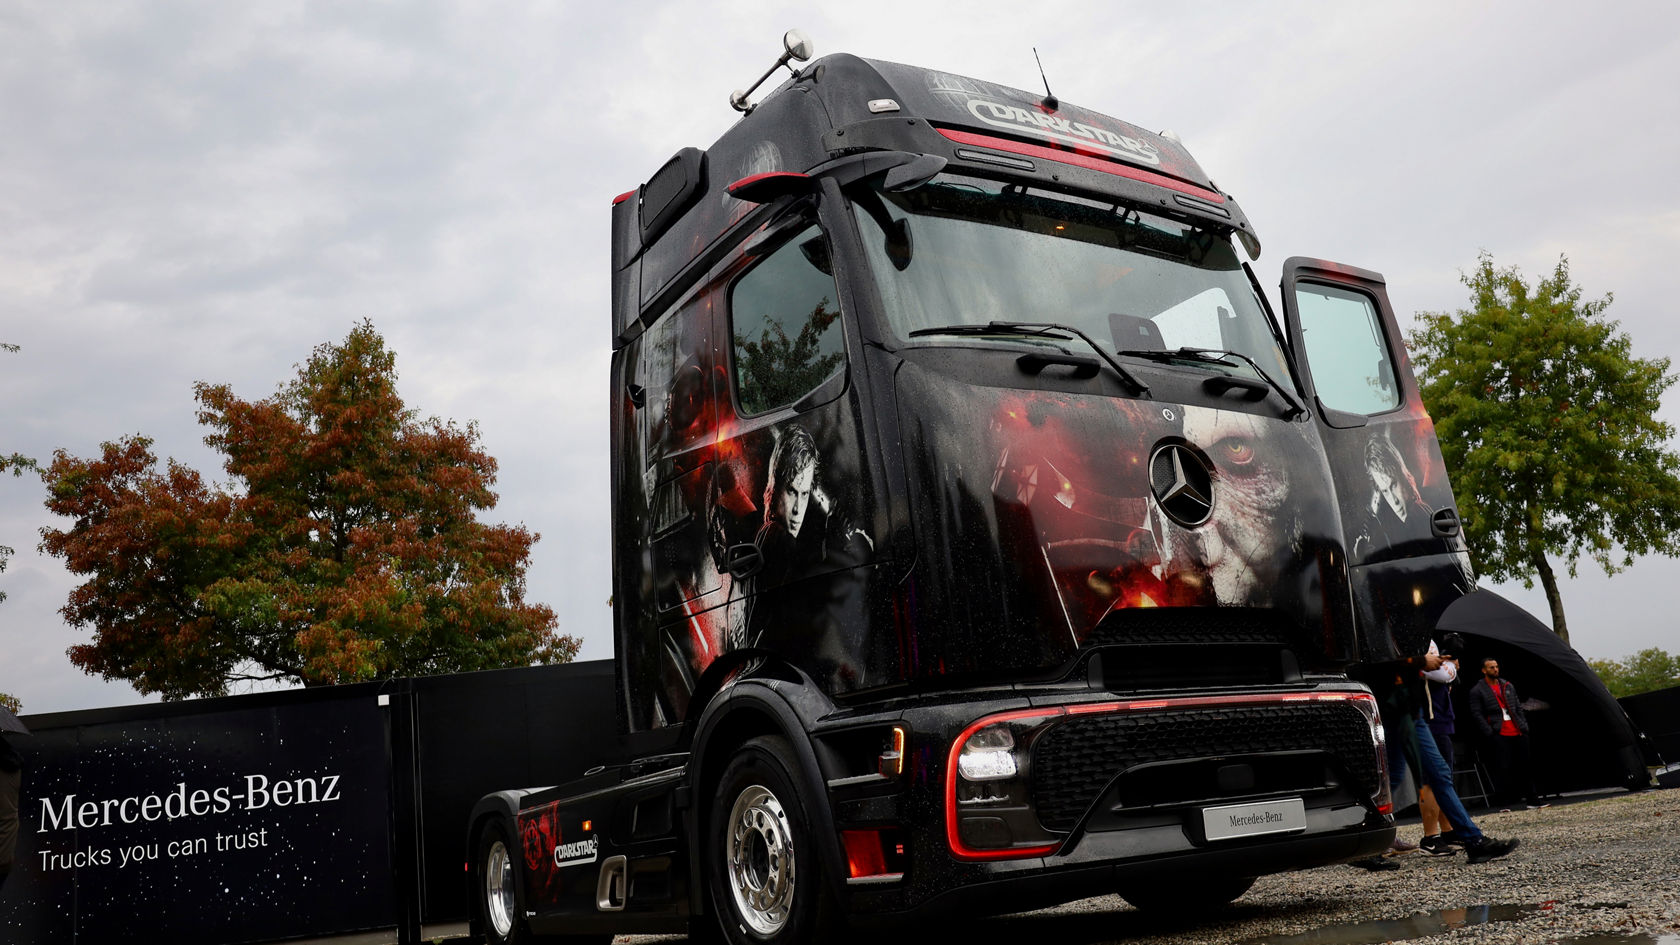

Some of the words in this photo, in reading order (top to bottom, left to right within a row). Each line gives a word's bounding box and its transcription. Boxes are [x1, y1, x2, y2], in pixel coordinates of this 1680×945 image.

[968, 100, 1159, 164] DARKSTAR
[37, 773, 341, 833] Mercedes-Benz
[1229, 811, 1283, 827] Mercedes-Benz
[38, 845, 112, 872] Trucks
[119, 842, 159, 868] you
[167, 837, 208, 858] can
[216, 827, 269, 851] trust
[555, 839, 598, 867] DARKSTAR
